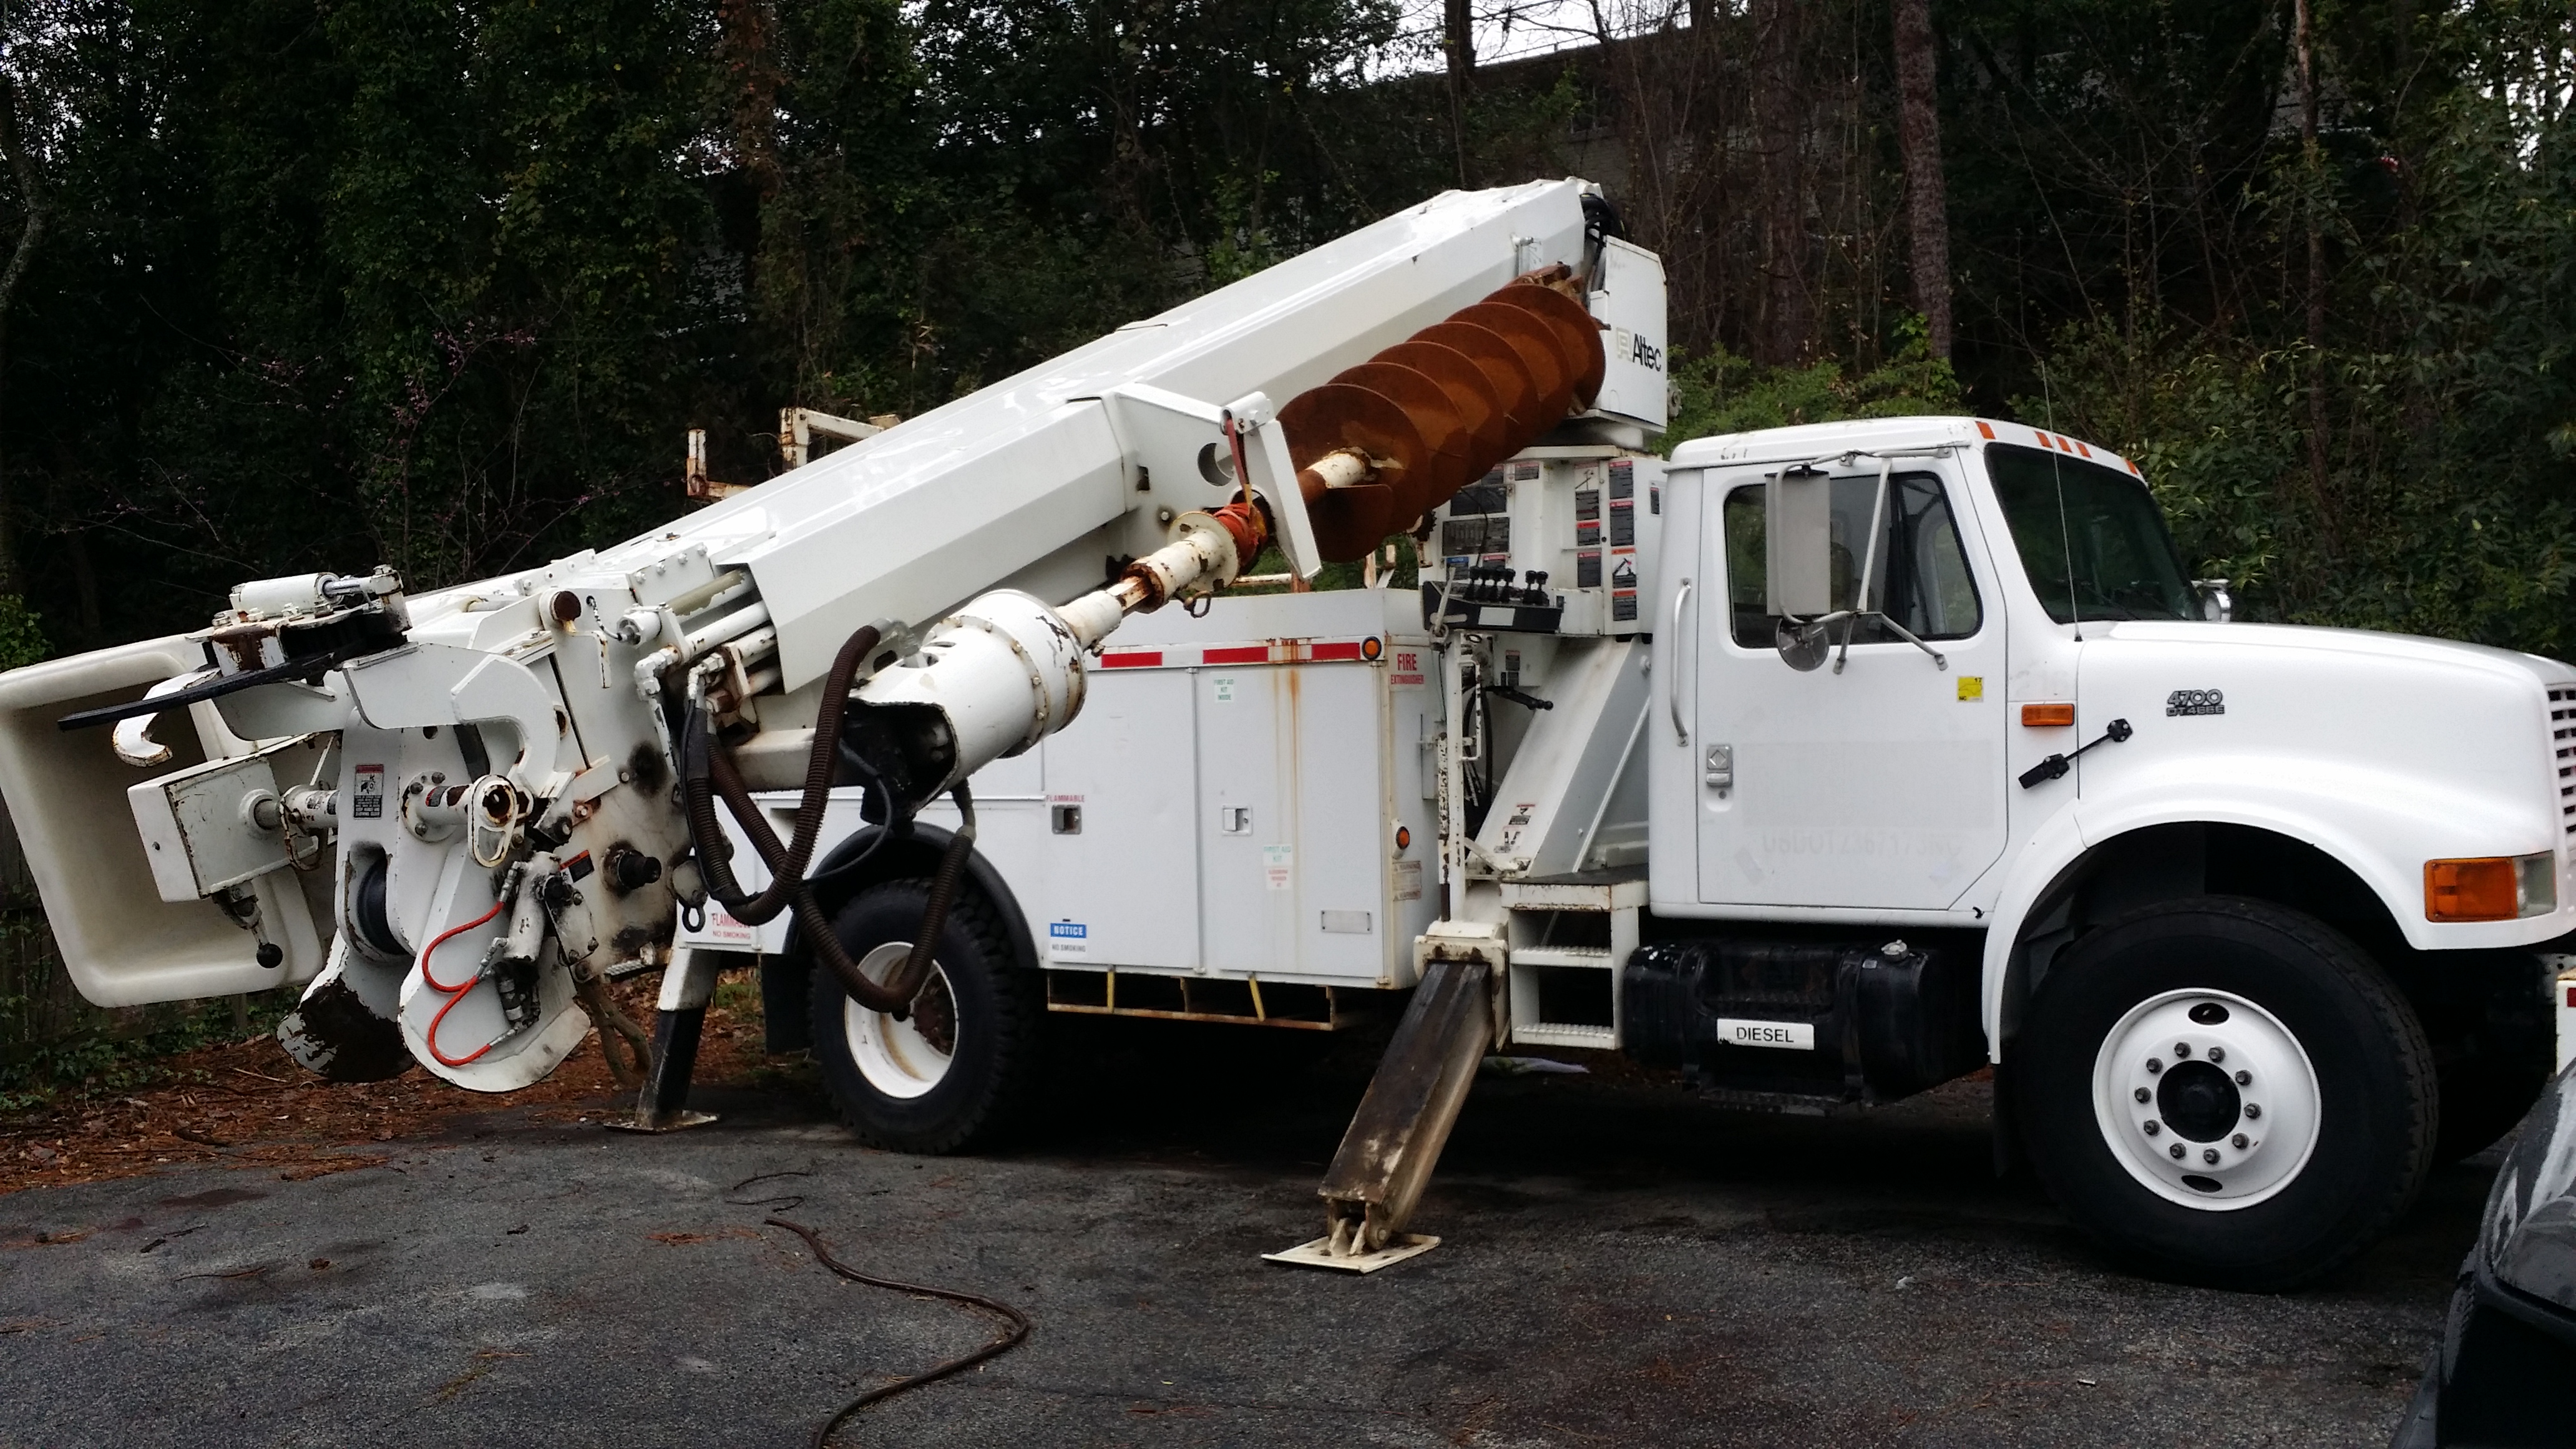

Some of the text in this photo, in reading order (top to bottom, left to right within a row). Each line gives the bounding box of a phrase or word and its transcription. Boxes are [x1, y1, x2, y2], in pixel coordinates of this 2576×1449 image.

[1632, 333, 1661, 372] Altec
[1397, 653, 1417, 671] FIRE
[2167, 688, 2223, 706] 4700
[1046, 794, 1085, 803] FLAMMABLE
[723, 931, 751, 939] SMOKING
[1054, 925, 1083, 936] NOTICE
[1061, 944, 1086, 952] SMOKING
[1736, 1027, 1794, 1043] DIESEL
